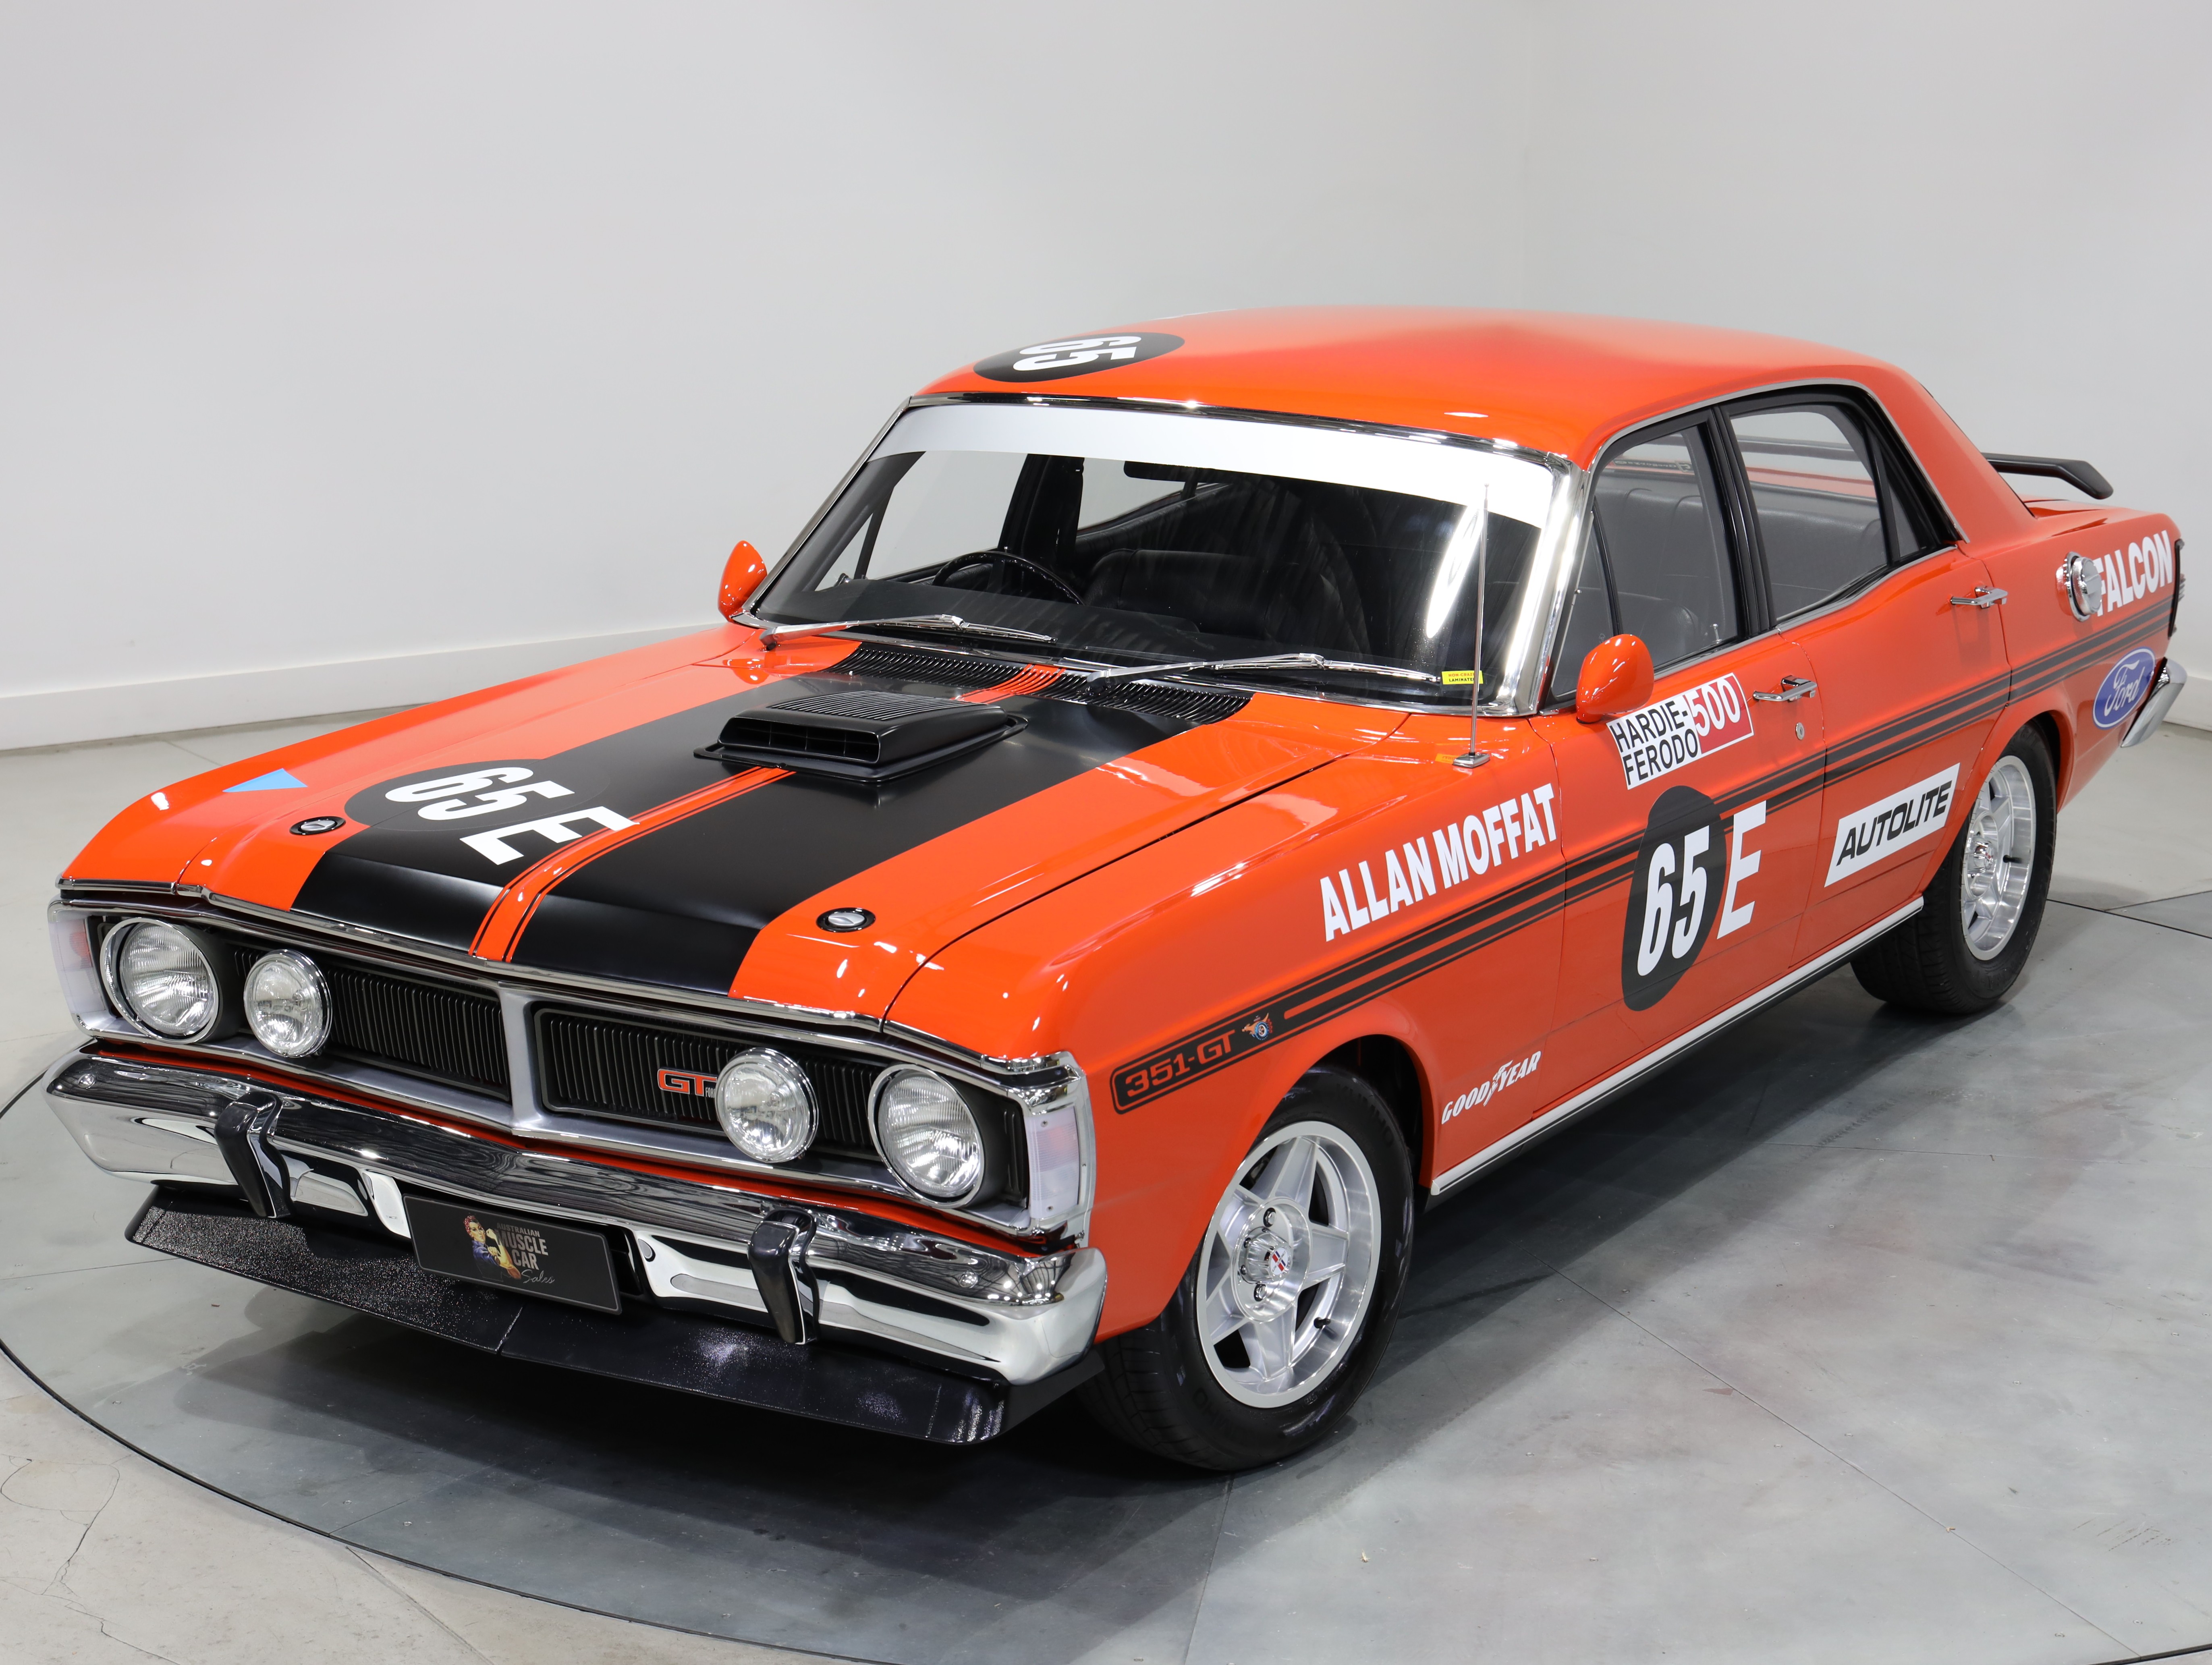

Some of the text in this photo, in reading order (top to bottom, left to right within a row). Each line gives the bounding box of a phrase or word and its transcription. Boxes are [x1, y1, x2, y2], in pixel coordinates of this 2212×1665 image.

[1013, 336, 1142, 371] 65
[1686, 678, 1741, 737] 500
[2104, 659, 2145, 717] Ford
[1609, 701, 1689, 753] HARDIE-
[1623, 728, 1698, 786] FERODO
[385, 766, 641, 865] 65 E
[1836, 780, 1953, 867] AUTOLITE
[1320, 783, 1557, 942] ALLAN MOFFAT
[1637, 800, 1767, 977] 65 E
[657, 1068, 717, 1097] GT
[1125, 1029, 1236, 1098] 351-GT
[1441, 1050, 1542, 1125] GOODYEAR
[495, 1230, 549, 1256] MUSCLE
[496, 1222, 541, 1238] AUSTRALIAN
[512, 1249, 540, 1270] CAR
[521, 1269, 555, 1284] Sales
